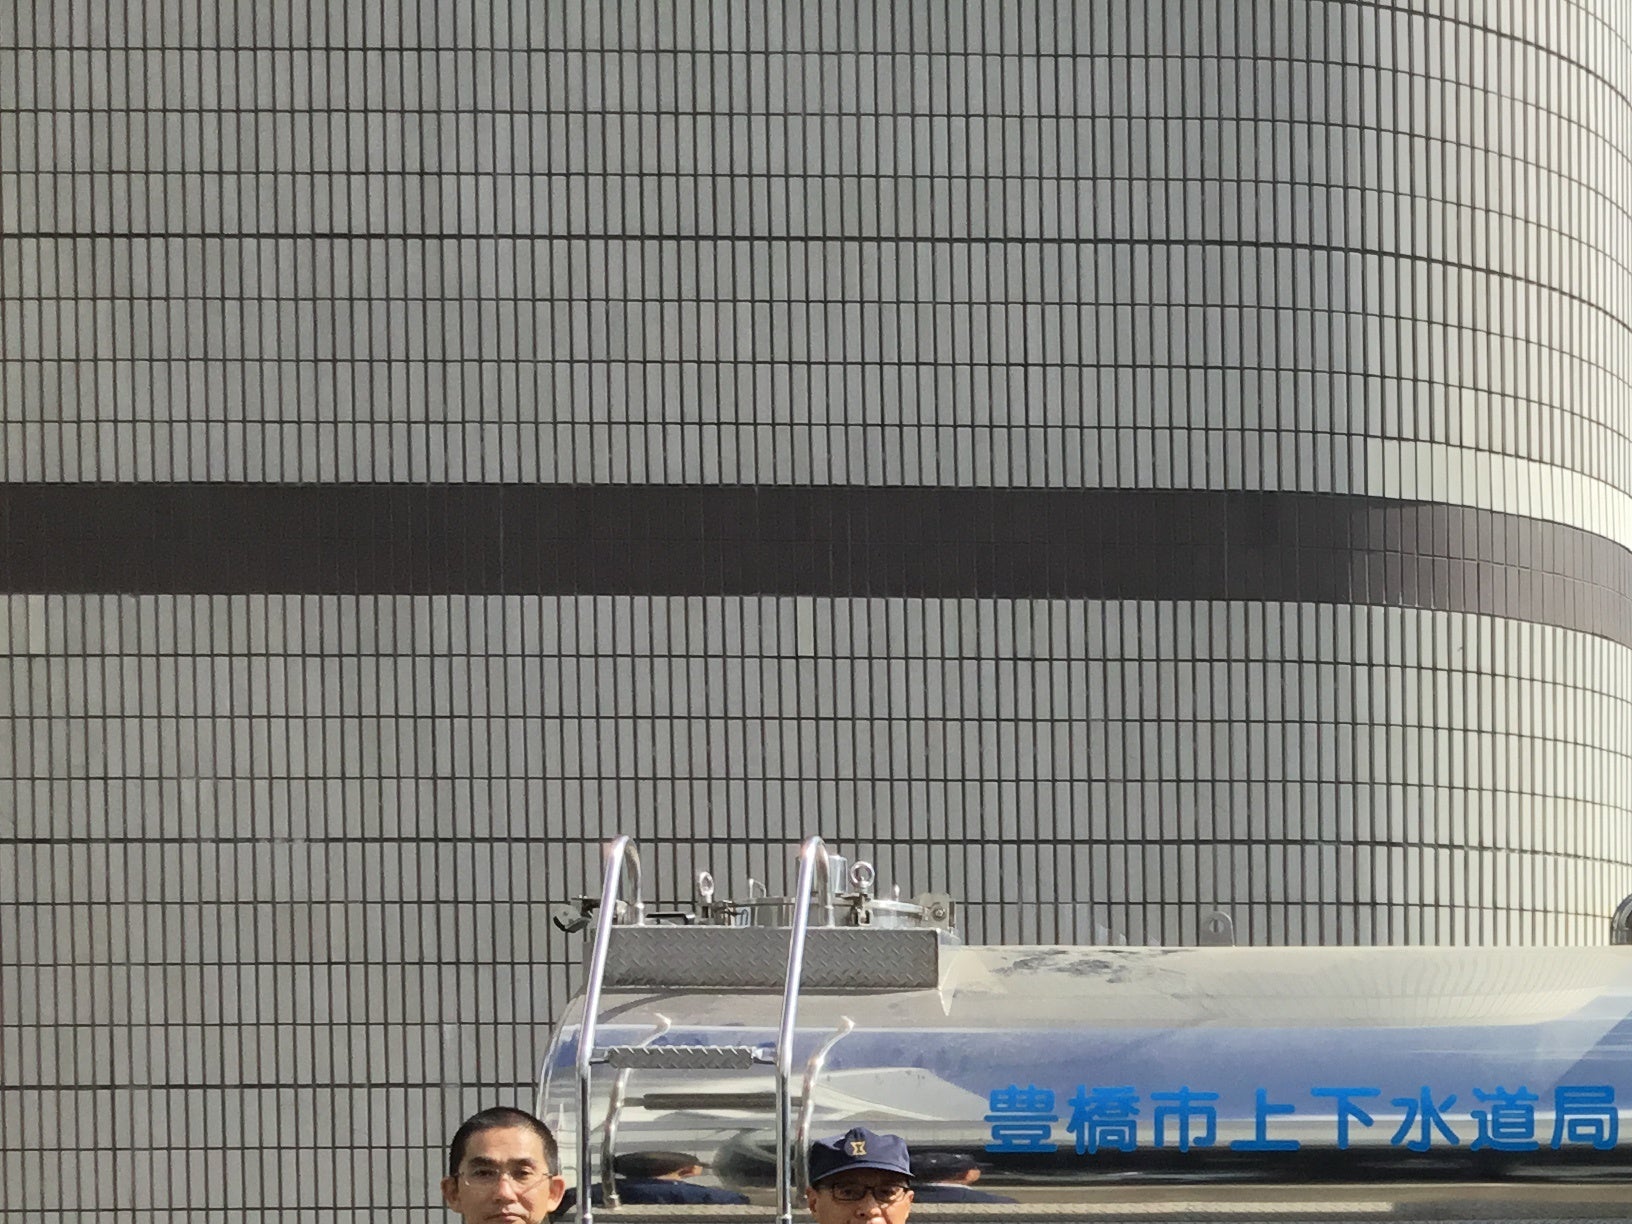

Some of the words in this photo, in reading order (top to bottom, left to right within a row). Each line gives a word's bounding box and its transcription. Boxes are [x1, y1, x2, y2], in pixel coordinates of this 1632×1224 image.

[984, 1084, 1620, 1155] 豊橋市上下水道局
